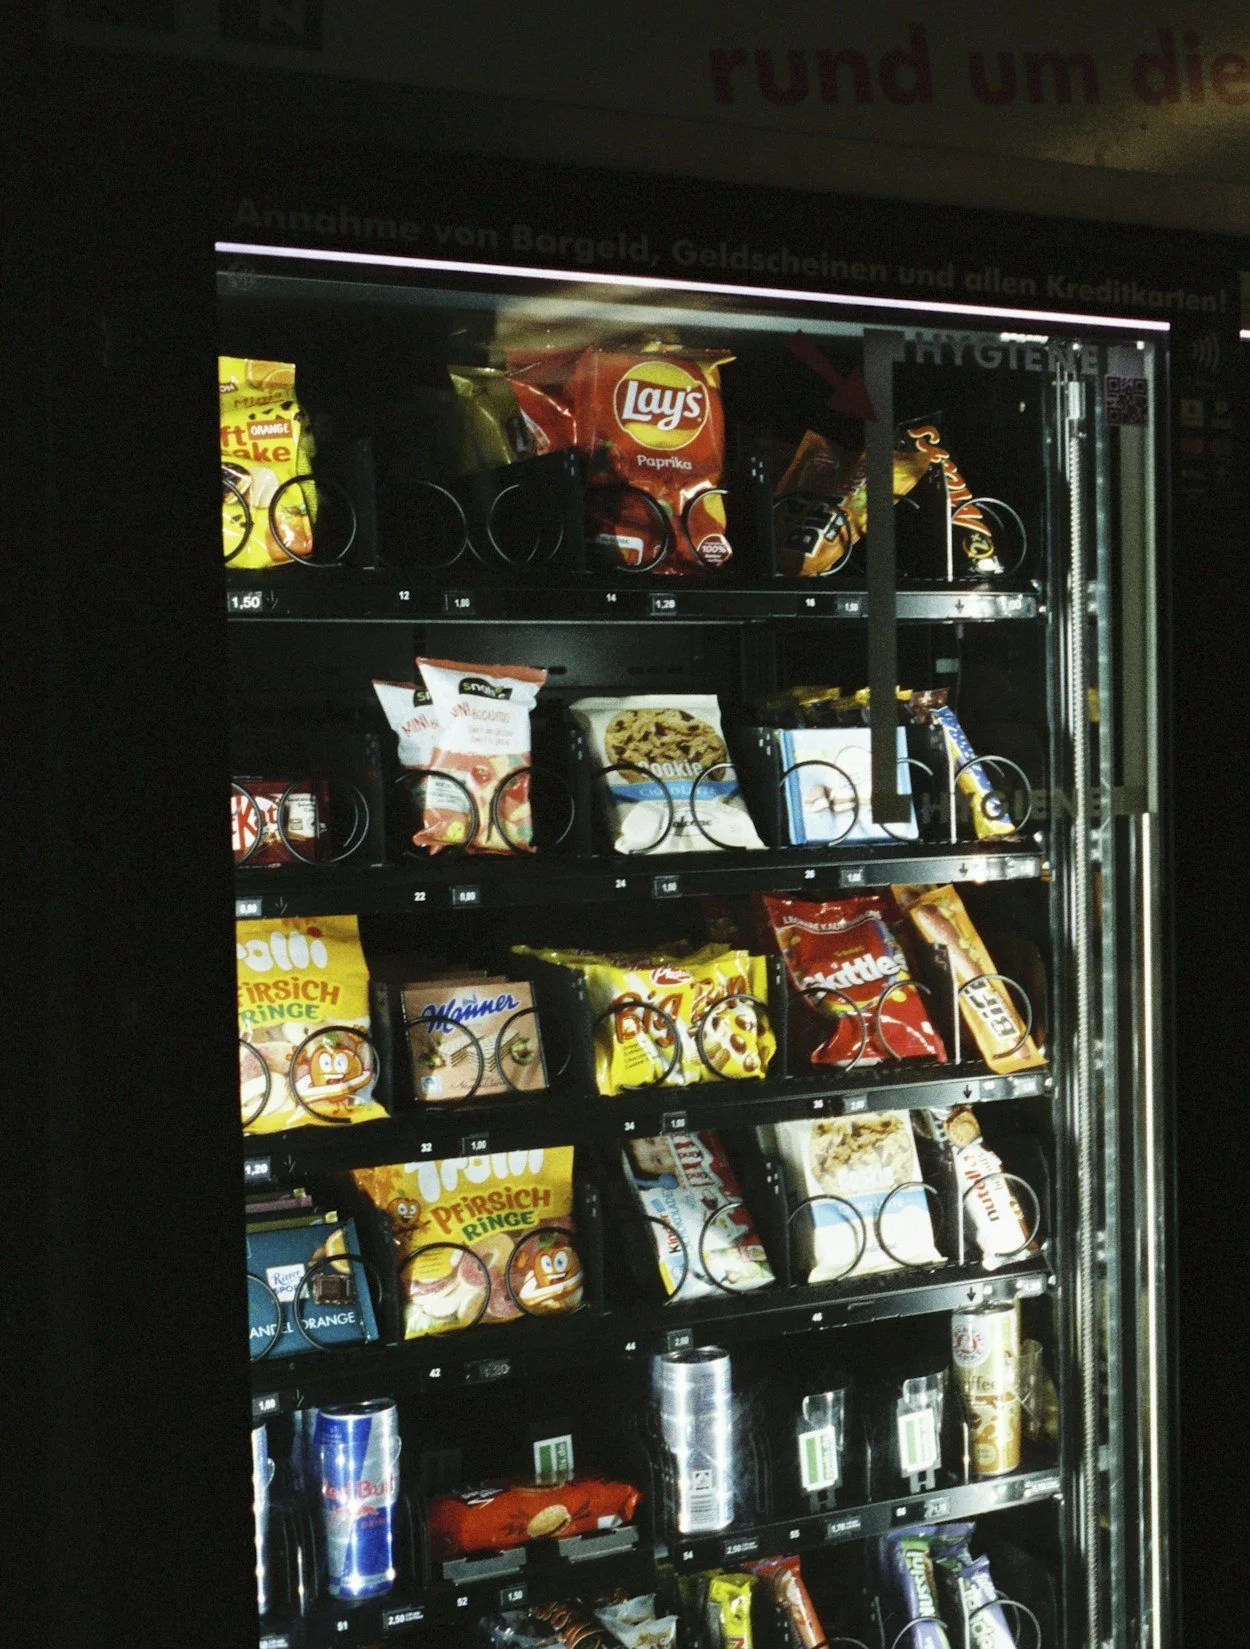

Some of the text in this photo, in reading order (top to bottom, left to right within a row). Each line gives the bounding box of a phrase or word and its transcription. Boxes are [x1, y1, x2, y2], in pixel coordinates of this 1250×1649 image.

[709, 24, 934, 106] rund
[968, 50, 1100, 106] um
[234, 197, 1228, 314] Annahme von Bargeld, Geldscheinen und allen Kreditkarten!
[621, 380, 703, 431] Lay's
[250, 421, 290, 436] ORANGE
[636, 454, 693, 472] Paprika
[398, 590, 410, 601] 12
[605, 593, 617, 602] 14
[231, 596, 261, 609] 1,50
[615, 878, 627, 889] 24
[414, 891, 427, 902] 22
[800, 951, 910, 996] Skittles
[421, 991, 521, 1035] Manner
[420, 1142, 433, 1153] 32
[429, 1368, 442, 1378] 42
[456, 1596, 468, 1607] 52
[337, 1620, 349, 1632] 51
